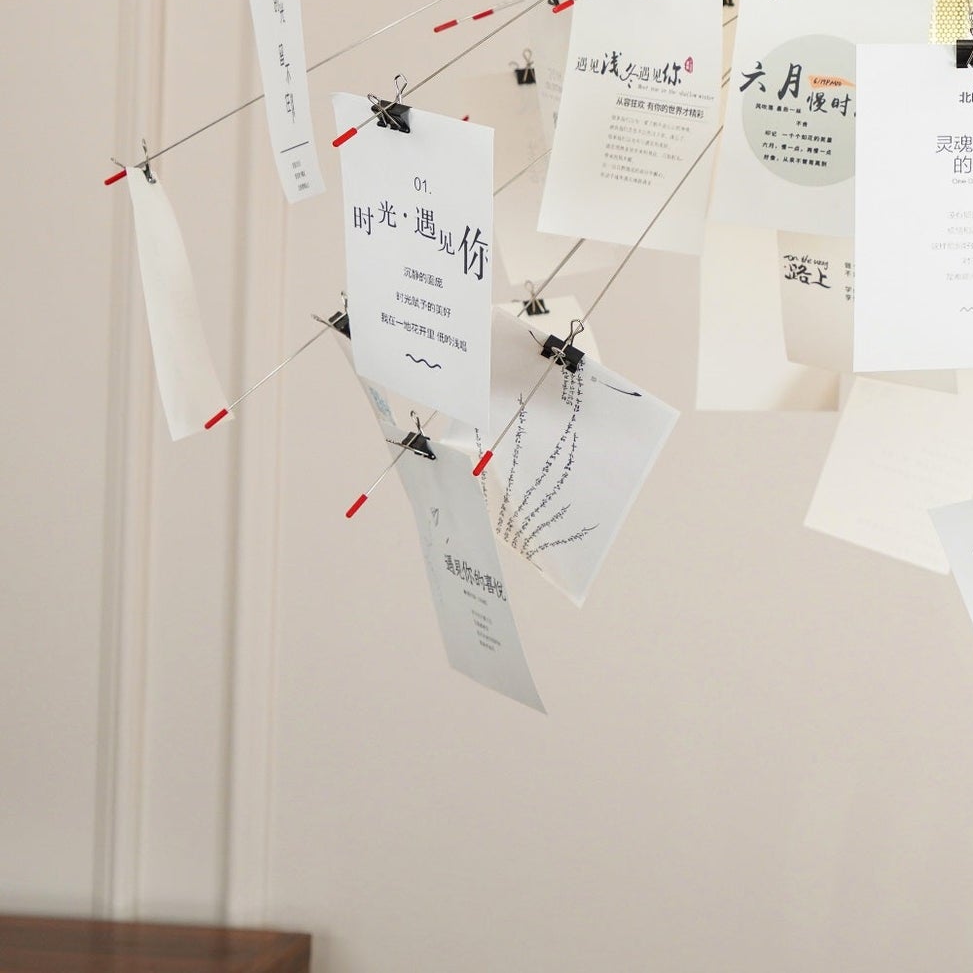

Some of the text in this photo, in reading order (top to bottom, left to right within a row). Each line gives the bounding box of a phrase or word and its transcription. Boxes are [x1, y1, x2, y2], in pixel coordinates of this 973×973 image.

[739, 60, 803, 101] 六月
[806, 91, 856, 117] 慢时
[413, 176, 432, 195] 01.
